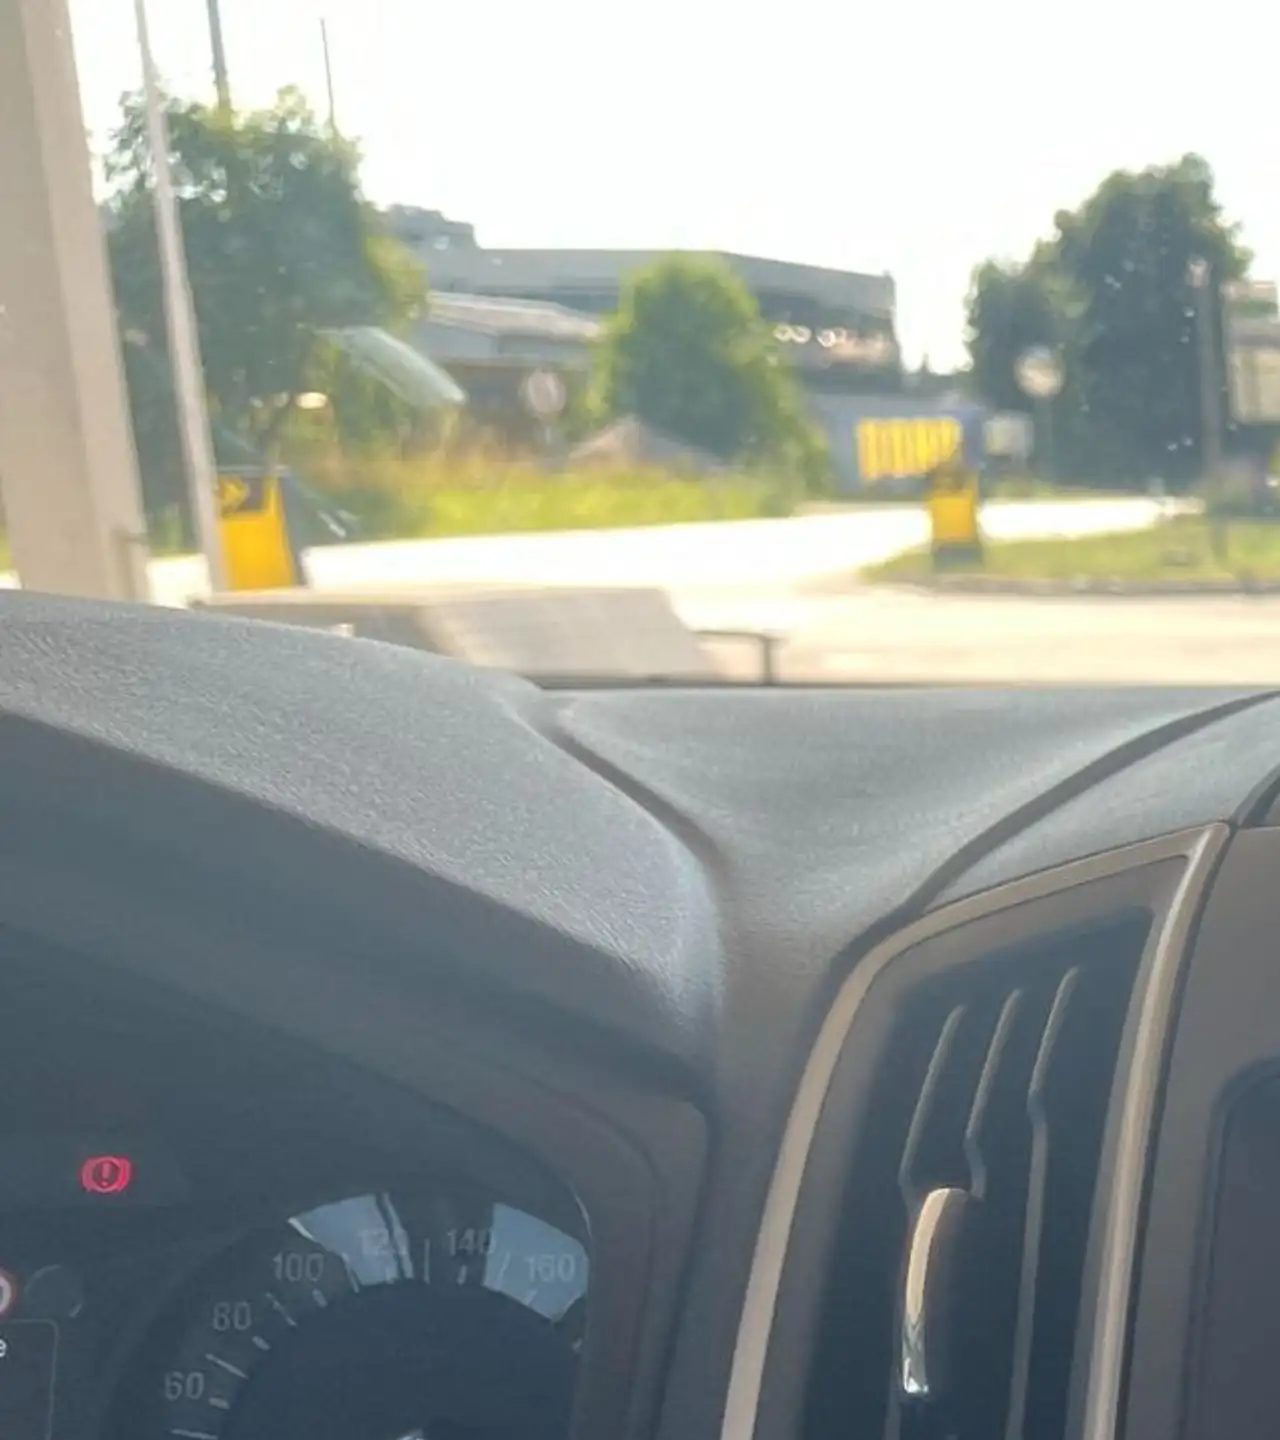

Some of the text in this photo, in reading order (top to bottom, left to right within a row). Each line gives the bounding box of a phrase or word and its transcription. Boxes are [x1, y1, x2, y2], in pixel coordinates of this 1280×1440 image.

[448, 1228, 497, 1257] 140
[272, 1252, 325, 1283] 100
[524, 1254, 576, 1283] 160
[213, 1302, 251, 1331] 80
[164, 1371, 205, 1401] 60
